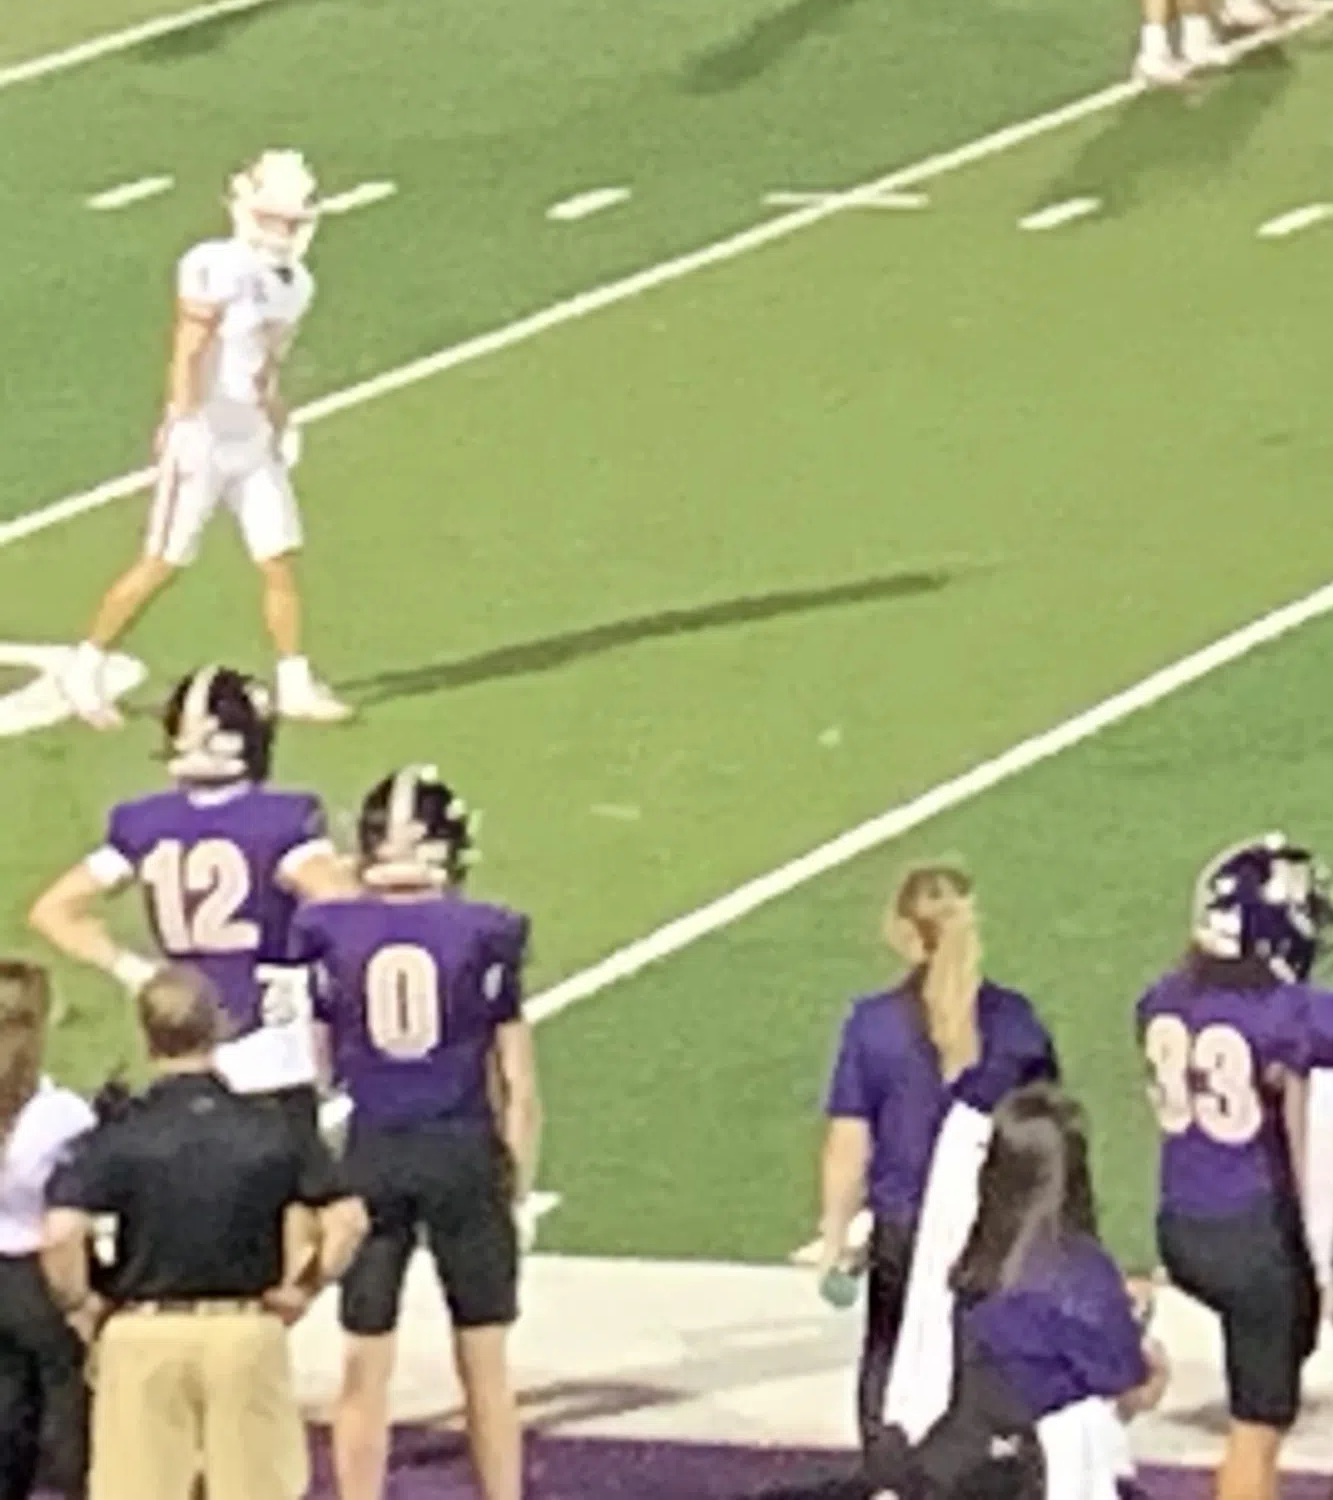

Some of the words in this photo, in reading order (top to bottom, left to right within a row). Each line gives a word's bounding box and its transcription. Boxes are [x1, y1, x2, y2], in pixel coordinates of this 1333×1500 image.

[141, 839, 260, 953] 12
[365, 944, 441, 1059] 0
[1145, 1013, 1262, 1144] 33
